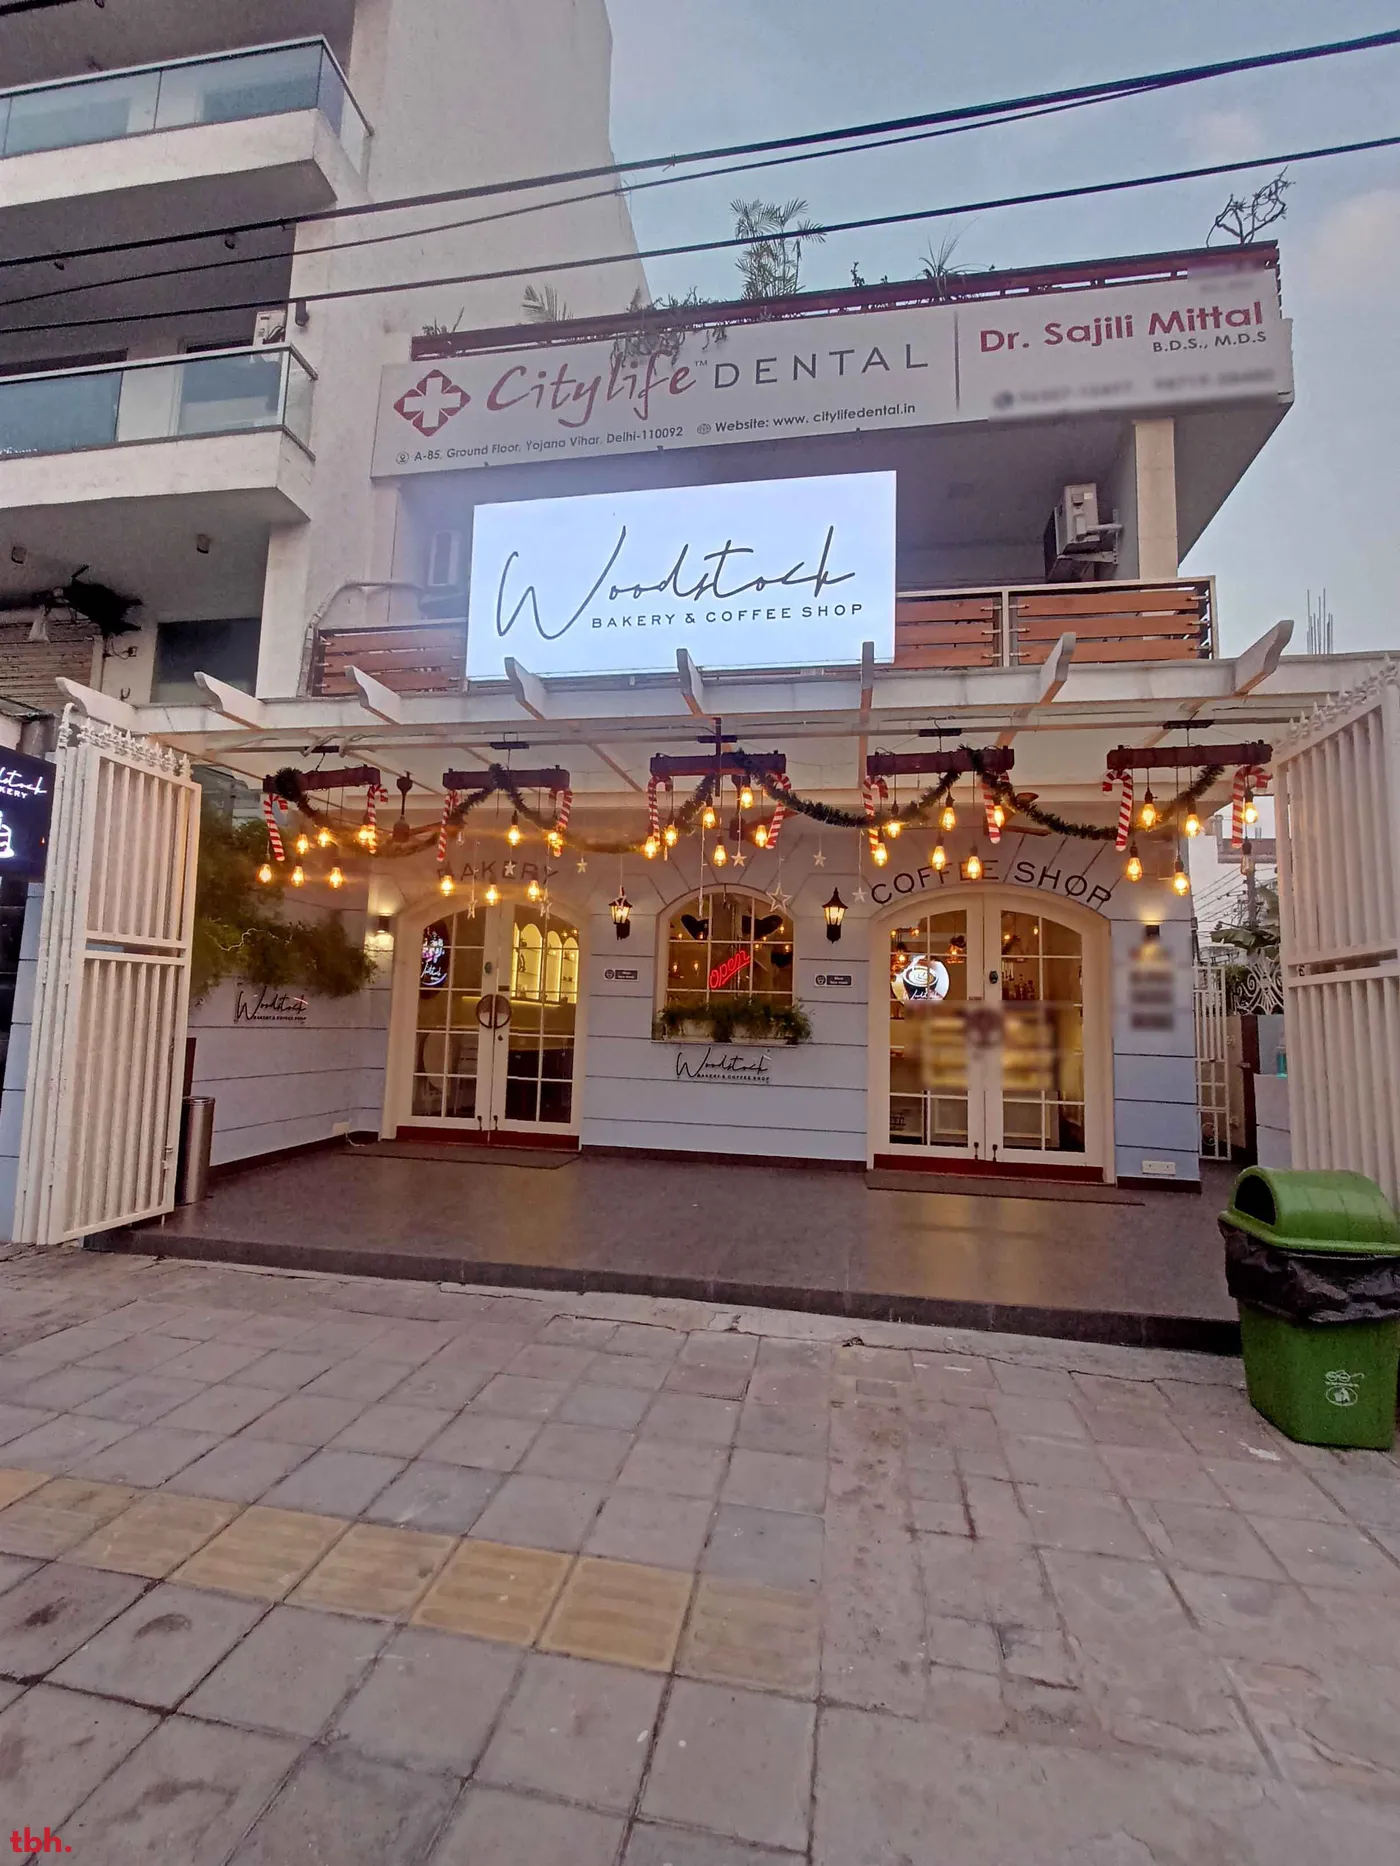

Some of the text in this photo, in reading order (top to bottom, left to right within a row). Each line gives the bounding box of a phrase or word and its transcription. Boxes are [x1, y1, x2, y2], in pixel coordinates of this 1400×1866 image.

[979, 301, 1263, 352] Dr. Sajili Mittal
[1214, 330, 1267, 347] M.D.S
[486, 349, 697, 428] Citylife
[713, 343, 929, 390] DENTAL
[446, 444, 489, 459] Ground
[525, 439, 566, 451] Yojana
[606, 426, 684, 444] Delhi-110092
[715, 417, 769, 433] Website:
[812, 403, 916, 424] citylifedental.in
[496, 525, 856, 640] Woodstock
[591, 603, 864, 629] BAKERY & COFFEE SHOP
[871, 859, 1112, 905] COFFEE SHOP
[709, 949, 751, 989] Open
[675, 1046, 769, 1078] Woodstock
